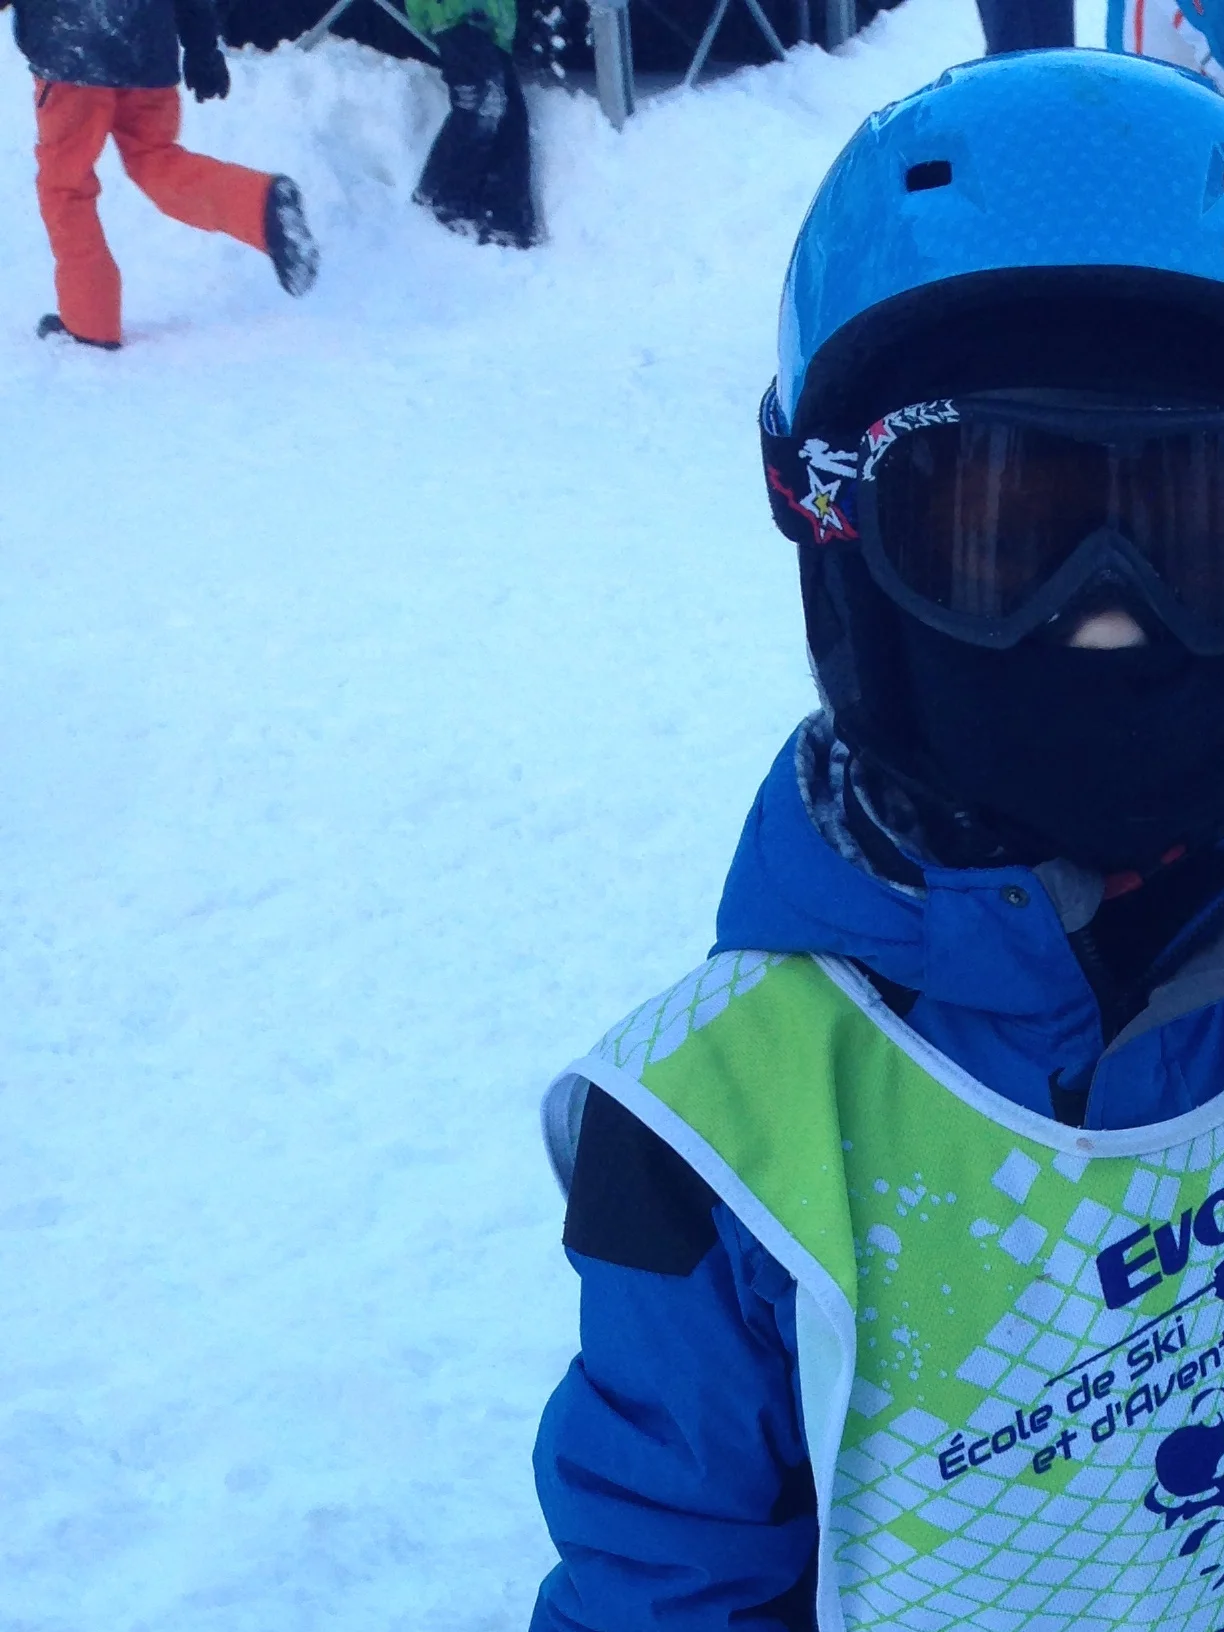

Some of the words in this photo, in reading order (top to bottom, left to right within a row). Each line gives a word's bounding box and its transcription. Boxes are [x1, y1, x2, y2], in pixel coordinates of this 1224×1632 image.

[938, 1403, 1054, 1481] École
[1066, 1373, 1115, 1414] de
[1126, 1316, 1188, 1381] Ski
[1032, 1431, 1078, 1474] et
